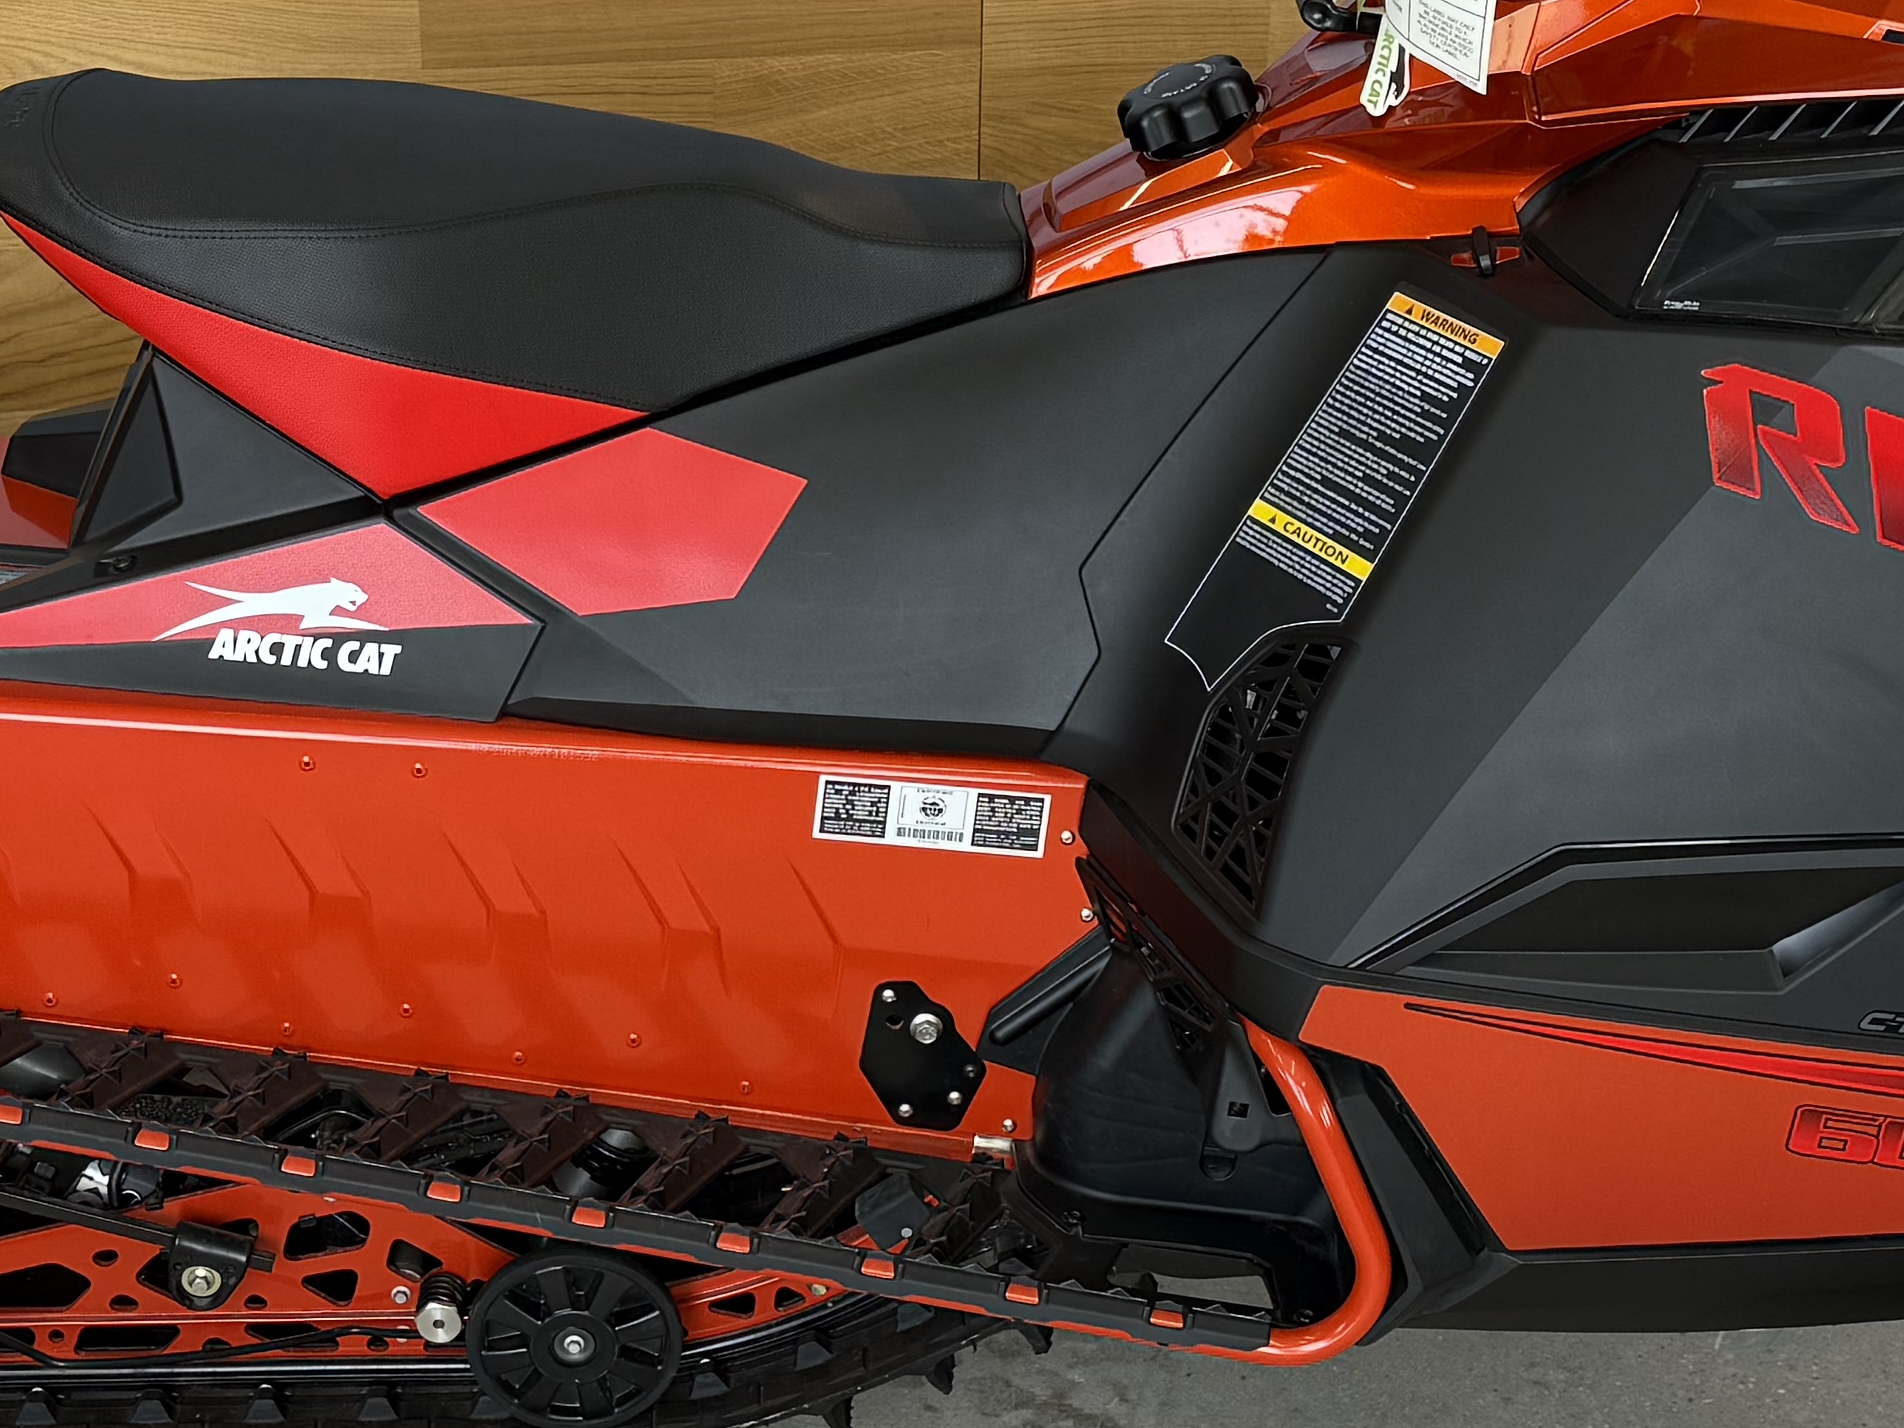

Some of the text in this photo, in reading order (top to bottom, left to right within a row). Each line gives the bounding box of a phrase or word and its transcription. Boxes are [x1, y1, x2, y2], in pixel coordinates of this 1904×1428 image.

[1367, 79, 1383, 110] CAT
[1420, 307, 1480, 345] WARNING
[1282, 521, 1349, 565] CAUTION
[207, 627, 402, 676] ARCTIC CAT
